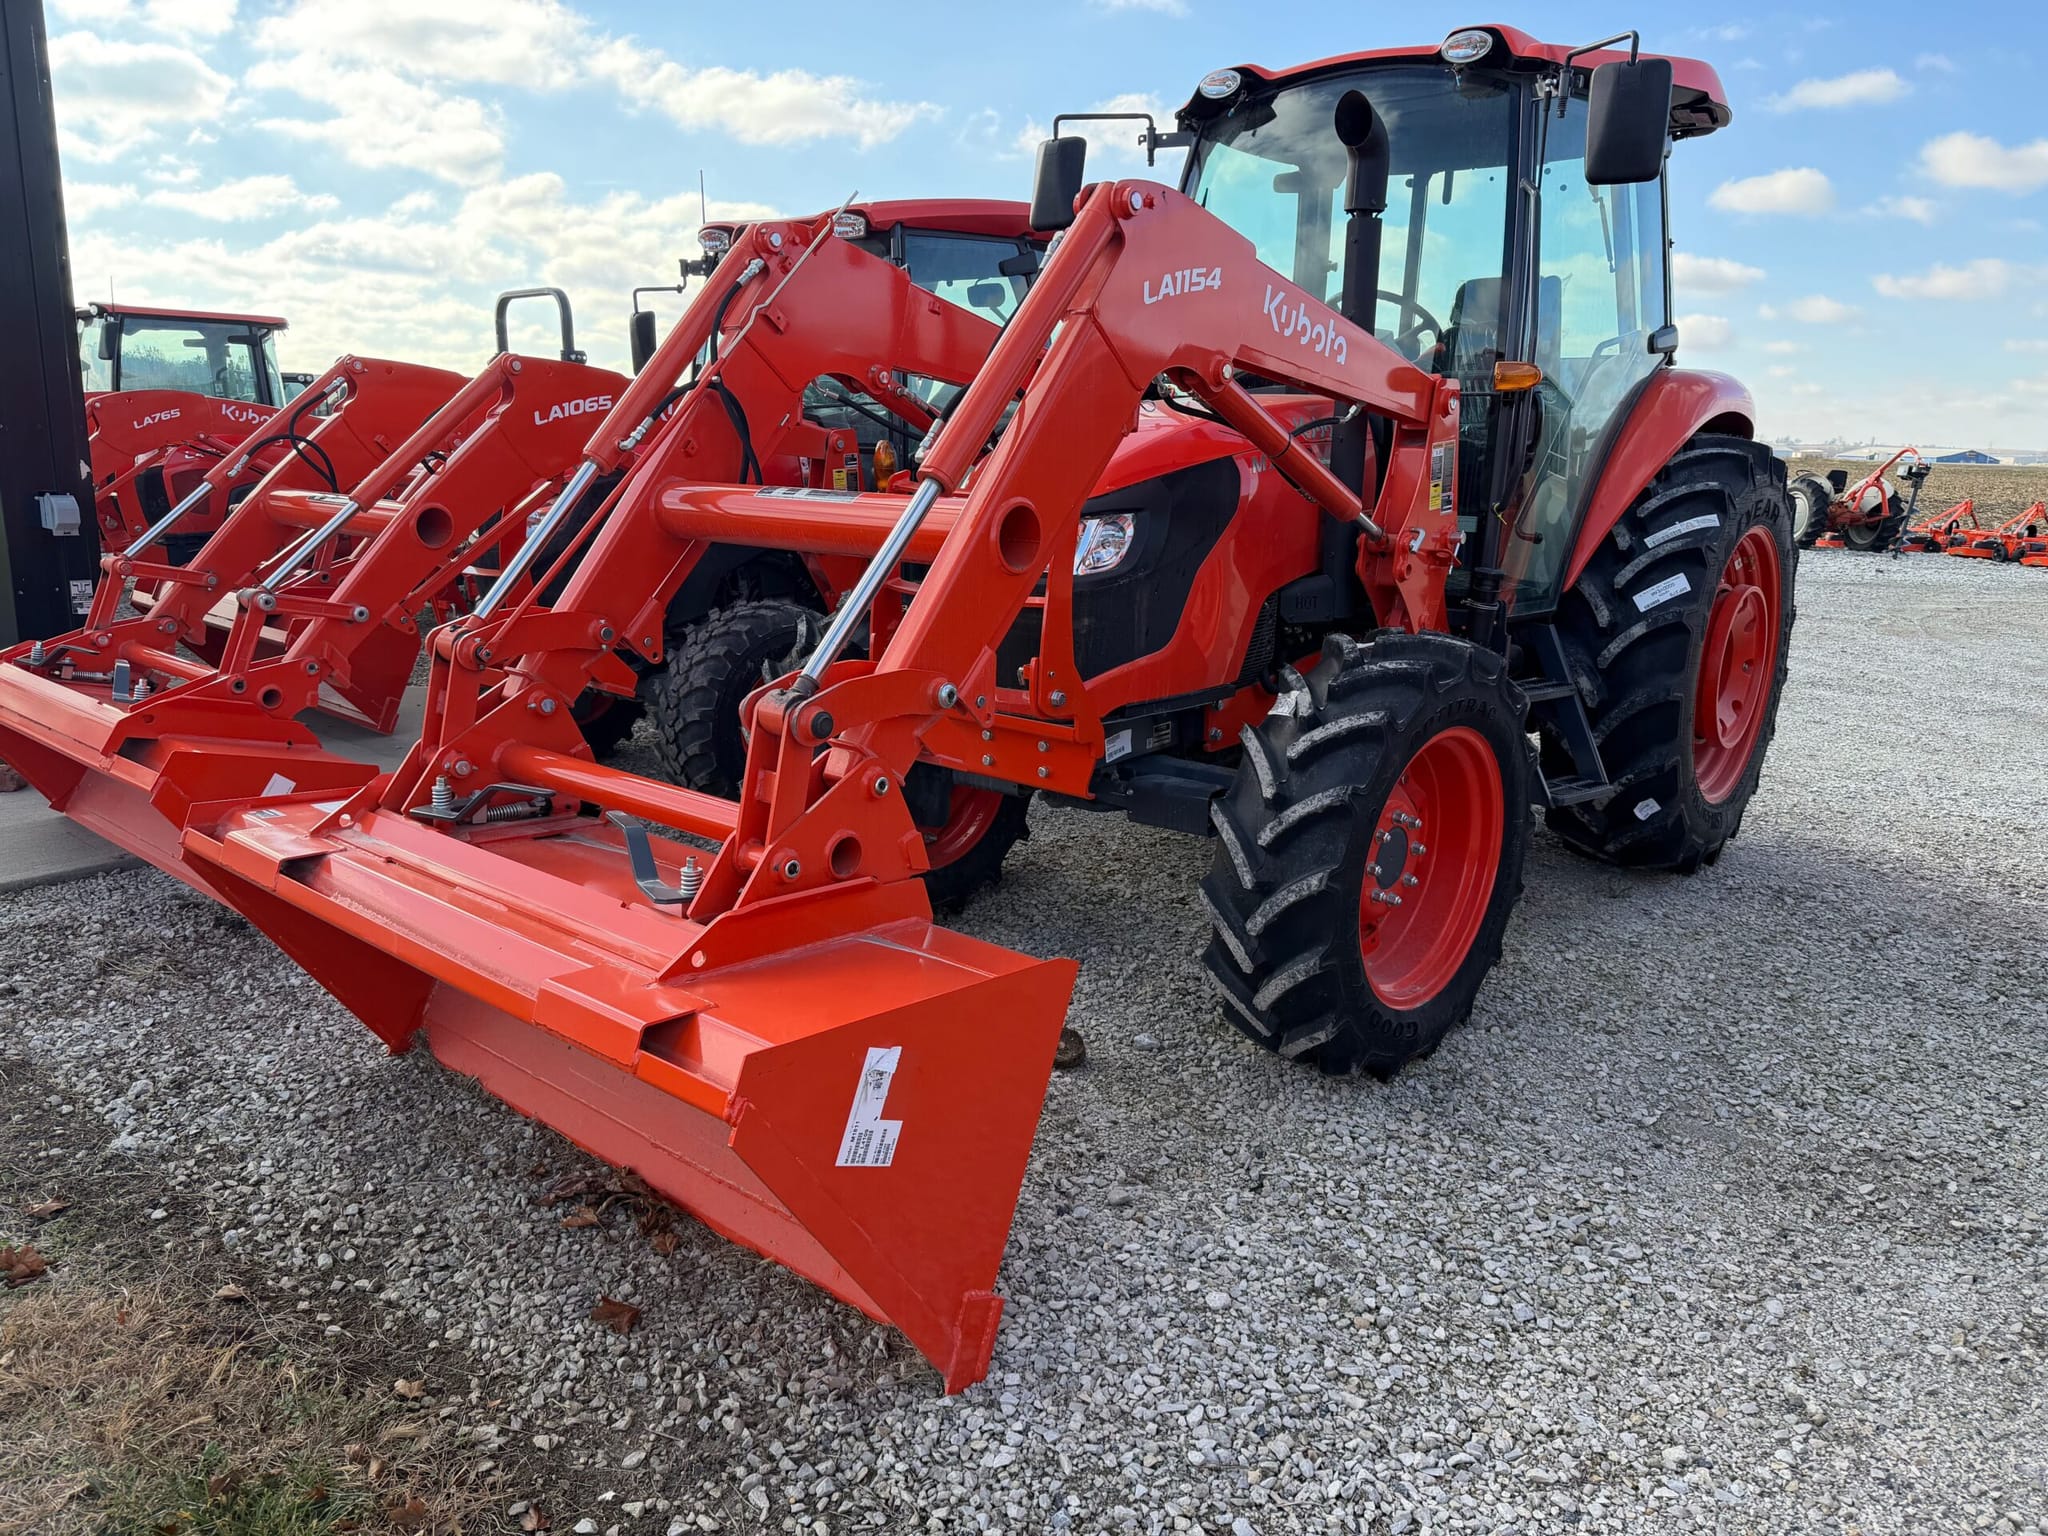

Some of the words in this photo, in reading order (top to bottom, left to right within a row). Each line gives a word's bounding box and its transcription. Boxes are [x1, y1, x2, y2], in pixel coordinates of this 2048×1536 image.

[1143, 267, 1222, 305] LA1154
[1263, 284, 1348, 365] Kubota
[133, 408, 181, 429] LA765
[221, 403, 276, 424] Kubo
[534, 395, 612, 426] LA1065
[1295, 594, 1319, 610] HOT
